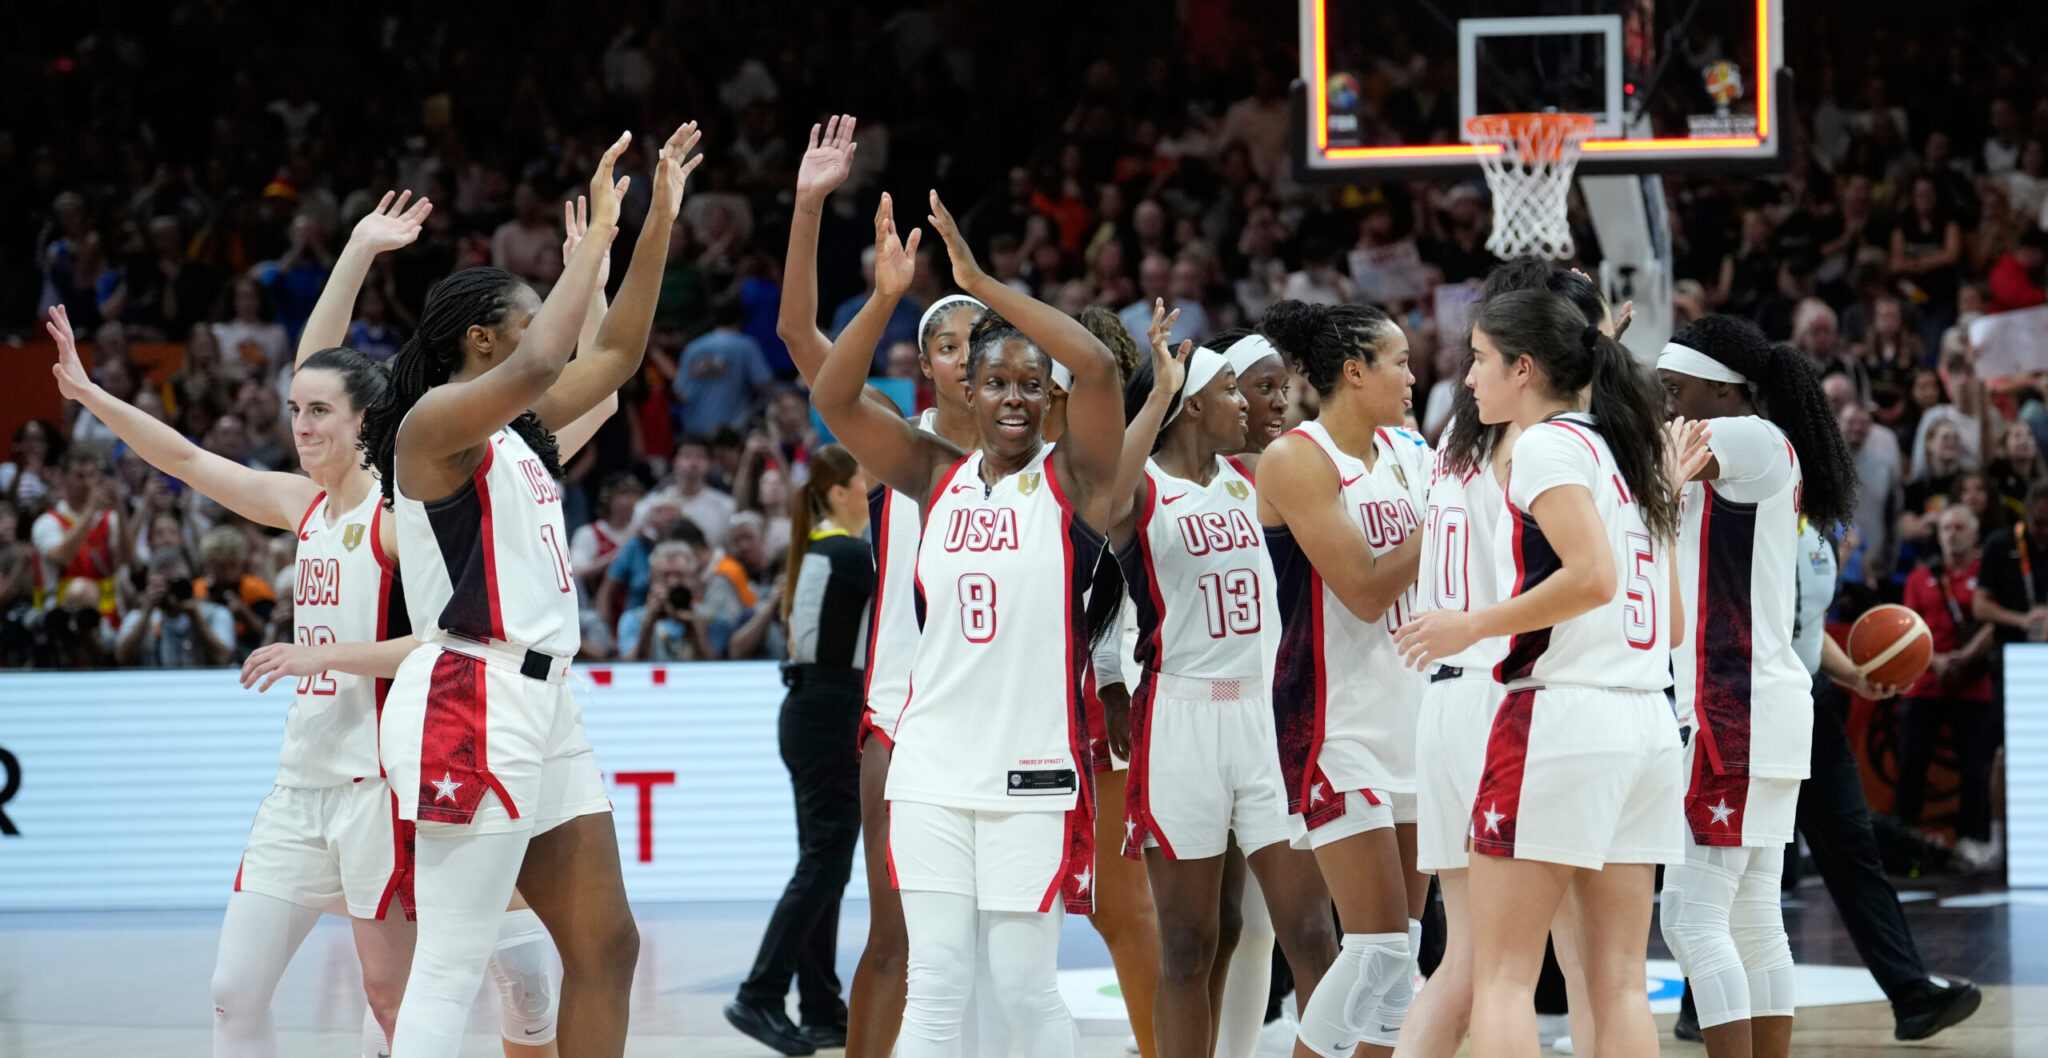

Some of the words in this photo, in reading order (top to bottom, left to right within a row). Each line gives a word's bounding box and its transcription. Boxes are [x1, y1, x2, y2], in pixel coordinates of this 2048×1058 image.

[944, 507, 1019, 552] USA
[1177, 508, 1260, 556] USA
[1360, 498, 1418, 548] USA
[295, 558, 340, 606] USA
[957, 572, 997, 644] 8
[1198, 567, 1261, 639] 13
[1623, 530, 1657, 651] 5
[296, 625, 337, 696] 12
